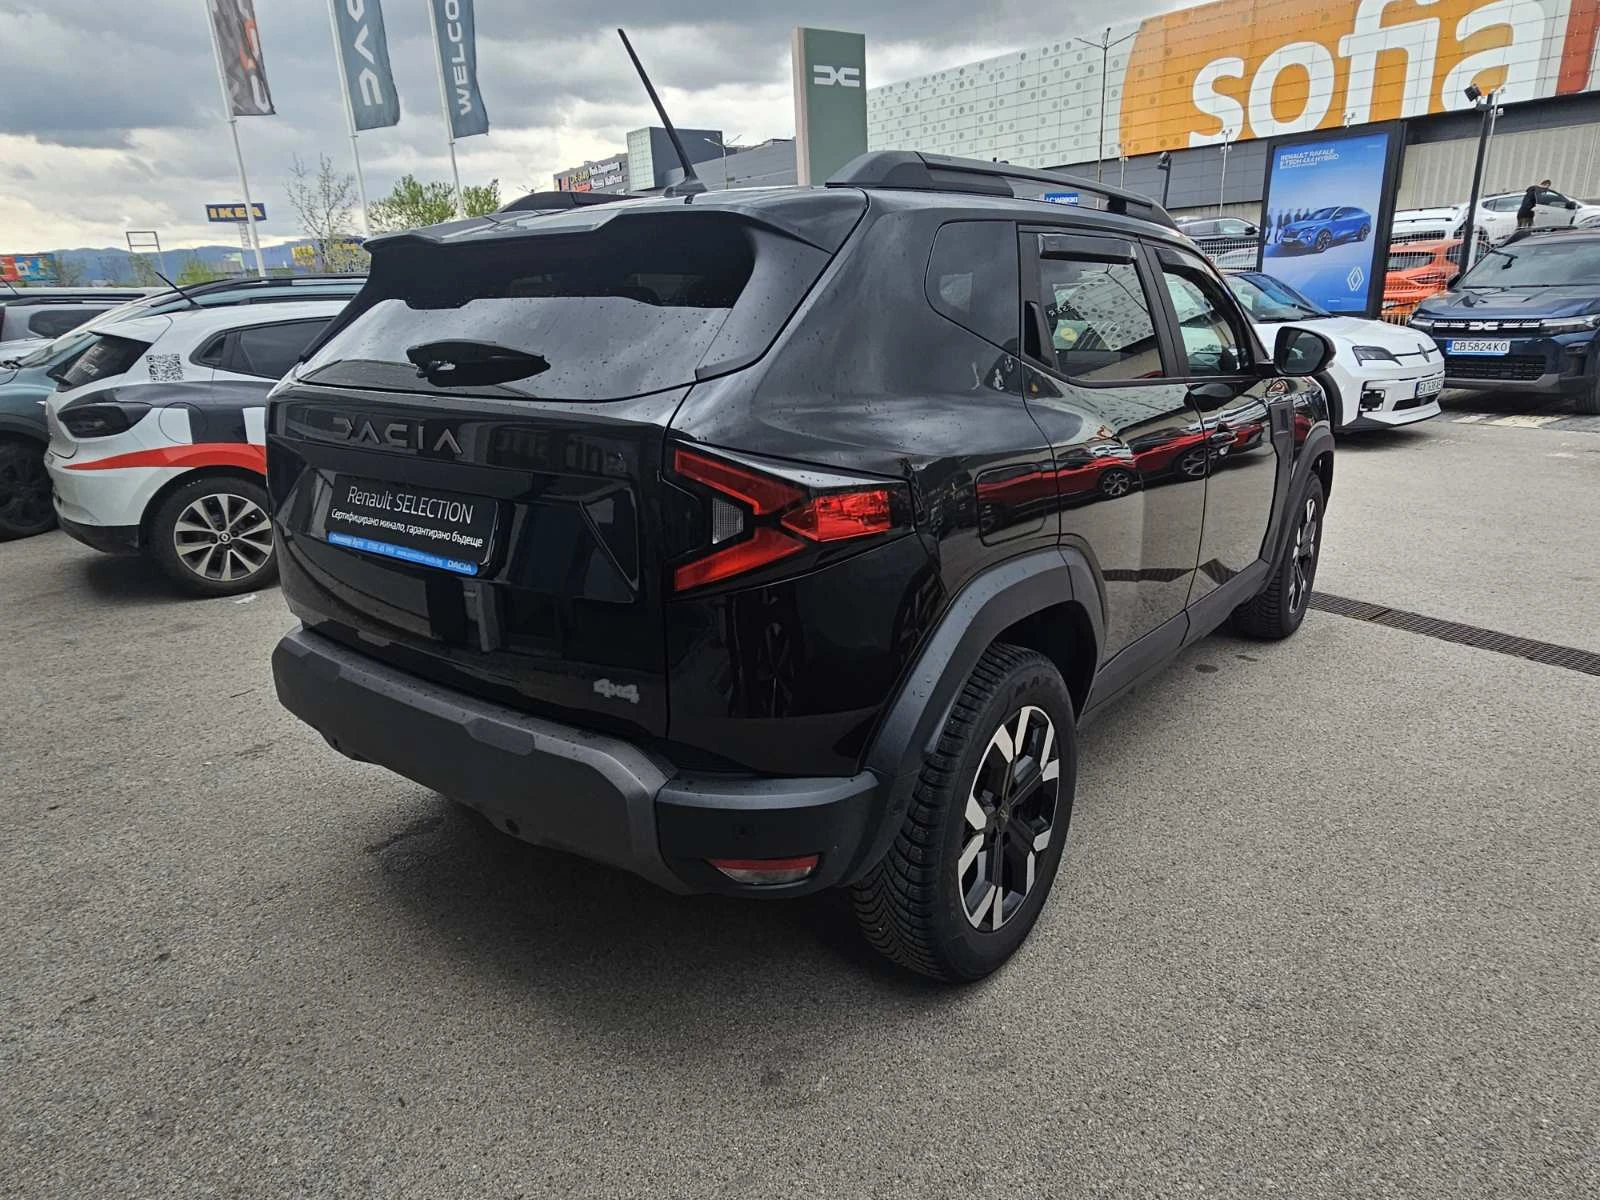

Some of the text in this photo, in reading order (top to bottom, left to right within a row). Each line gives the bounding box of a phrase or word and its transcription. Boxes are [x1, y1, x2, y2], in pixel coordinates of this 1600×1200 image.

[208, 206, 264, 218] IKEA
[332, 416, 463, 454] DACIA
[347, 486, 474, 525] Renault SELECTION
[406, 524, 450, 541] гарантирано
[451, 530, 484, 549] бъдеще
[447, 559, 472, 573] DACIA
